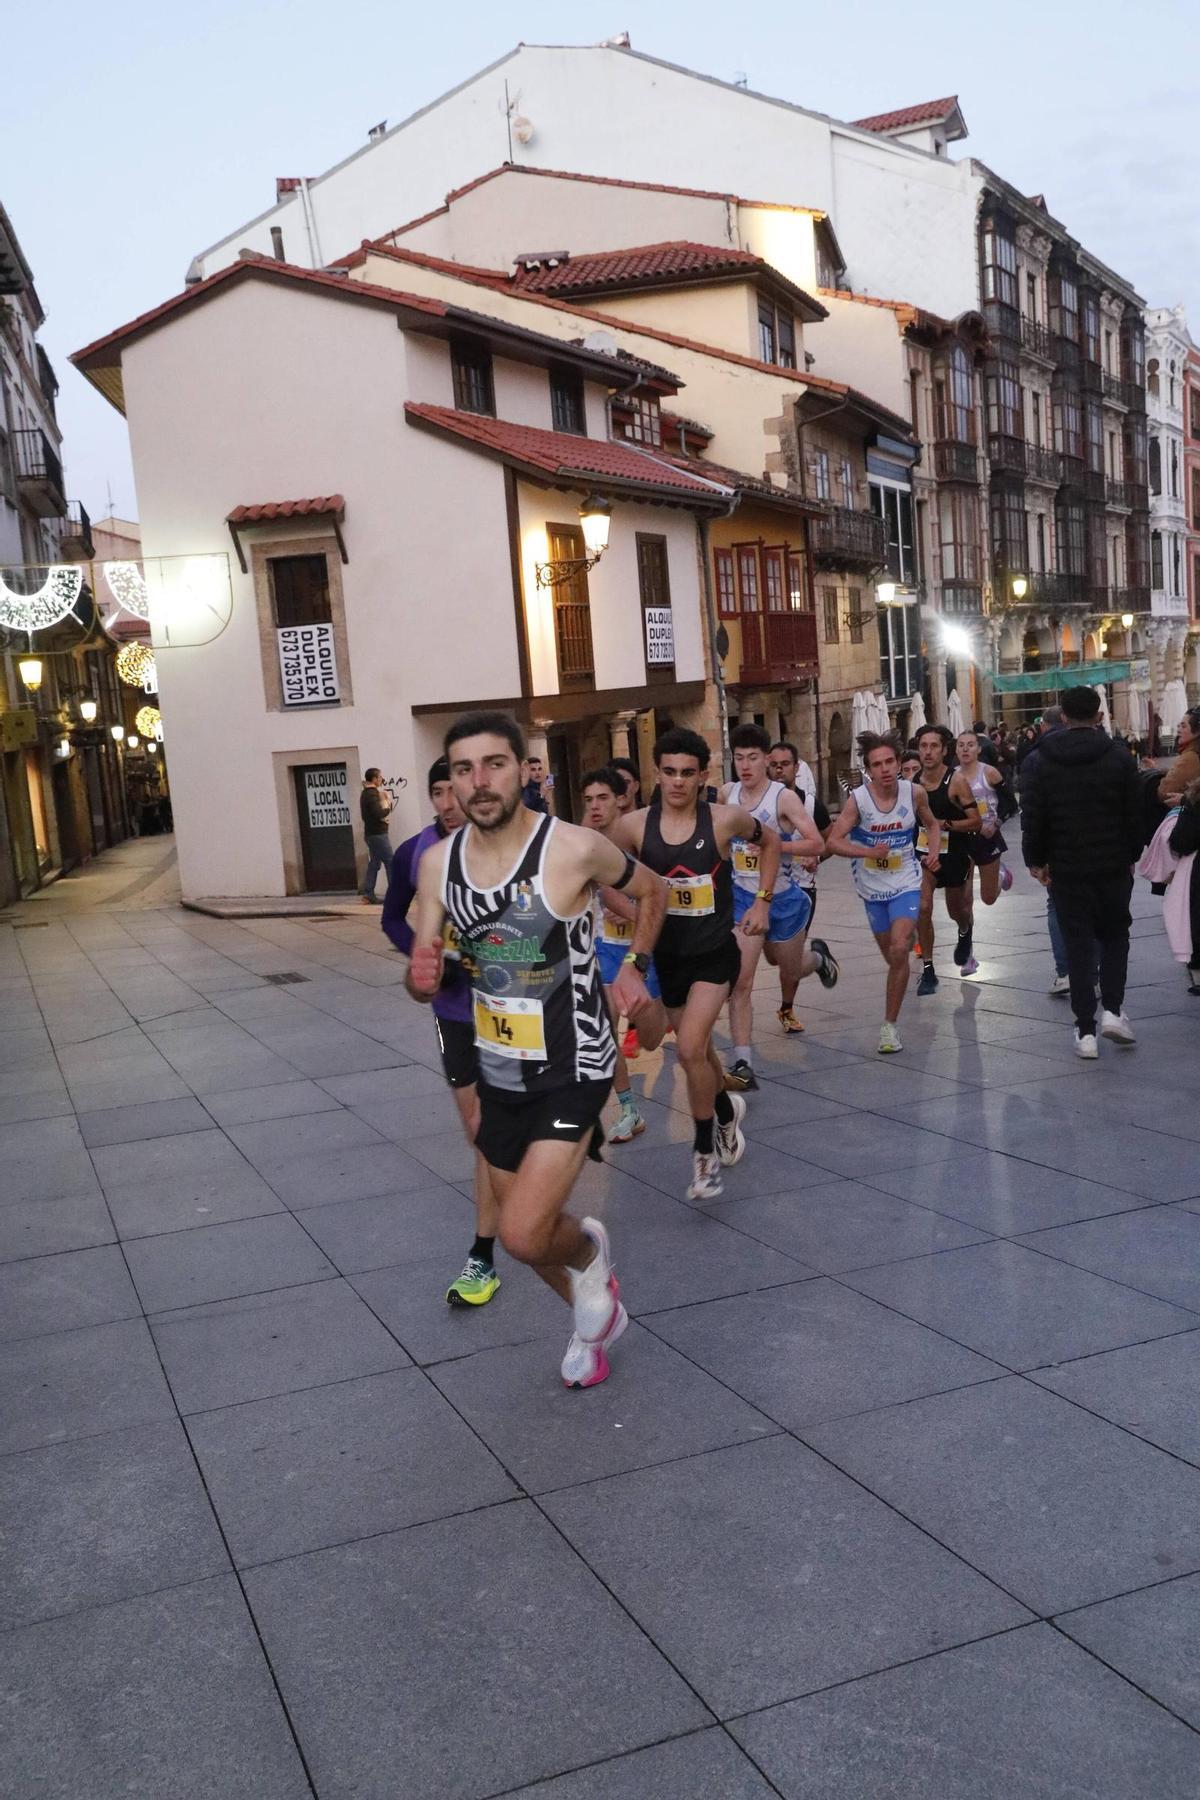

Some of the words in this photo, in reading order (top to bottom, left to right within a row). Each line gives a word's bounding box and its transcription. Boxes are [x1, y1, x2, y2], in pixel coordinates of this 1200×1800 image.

[301, 630, 320, 696] DUPLEX
[317, 626, 336, 697] ALQUILO
[307, 771, 347, 788] ALQUILO
[314, 790, 344, 806] LOCAL
[745, 856, 758, 868] 57
[876, 858, 889, 869] 50
[676, 890, 692, 905] 19
[468, 922, 525, 939] RESTAURANTE
[492, 1016, 513, 1040] 14
